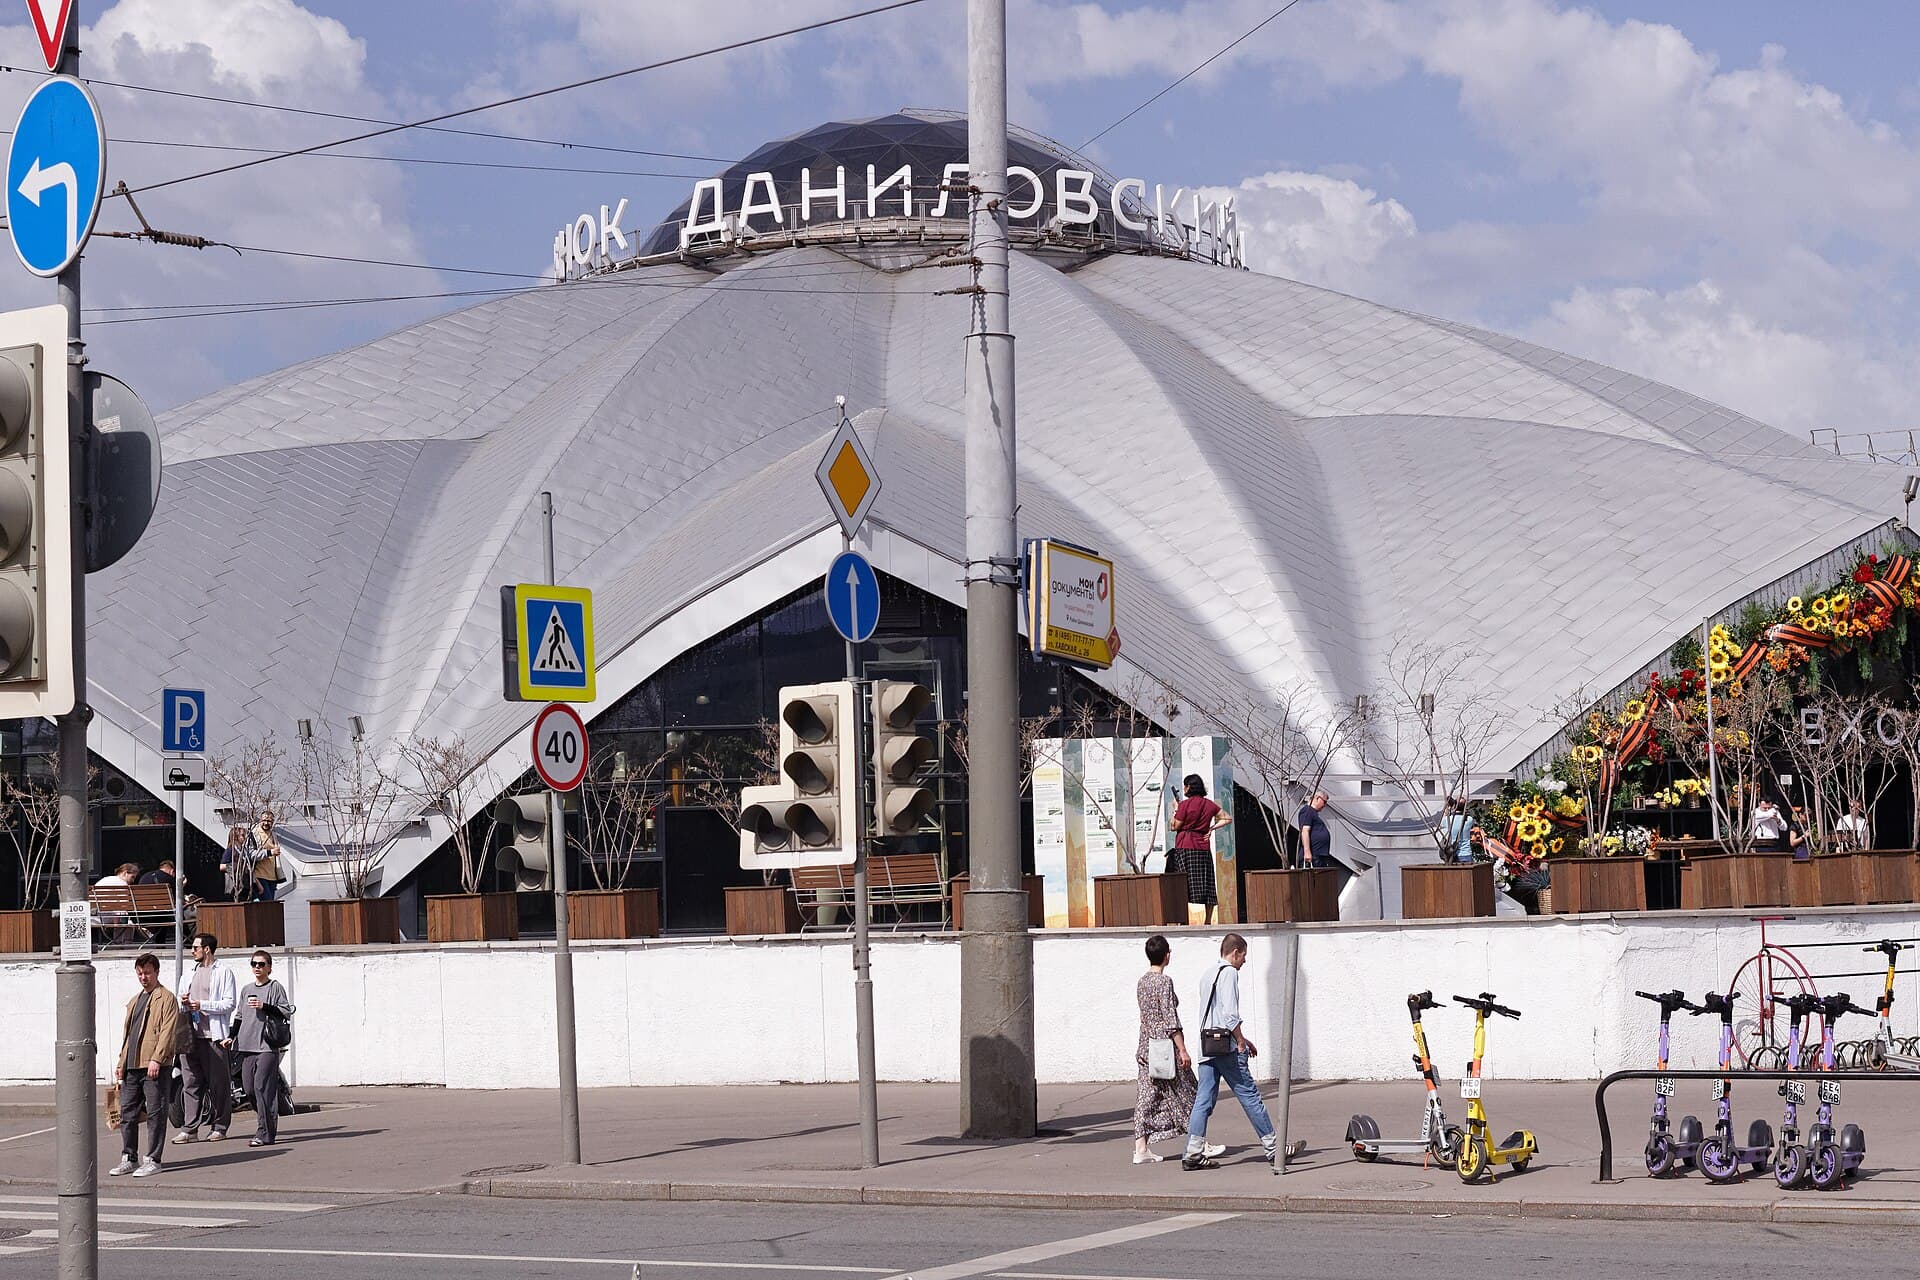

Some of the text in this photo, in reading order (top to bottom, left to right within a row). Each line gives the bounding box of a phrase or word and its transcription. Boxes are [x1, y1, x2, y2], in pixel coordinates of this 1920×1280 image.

[681, 163, 1246, 267] ДАНИЛОВСКИЙ
[1052, 580, 1094, 600] документы
[175, 696, 198, 745] P
[1801, 707, 1920, 755] ВХО
[545, 731, 577, 763] 40
